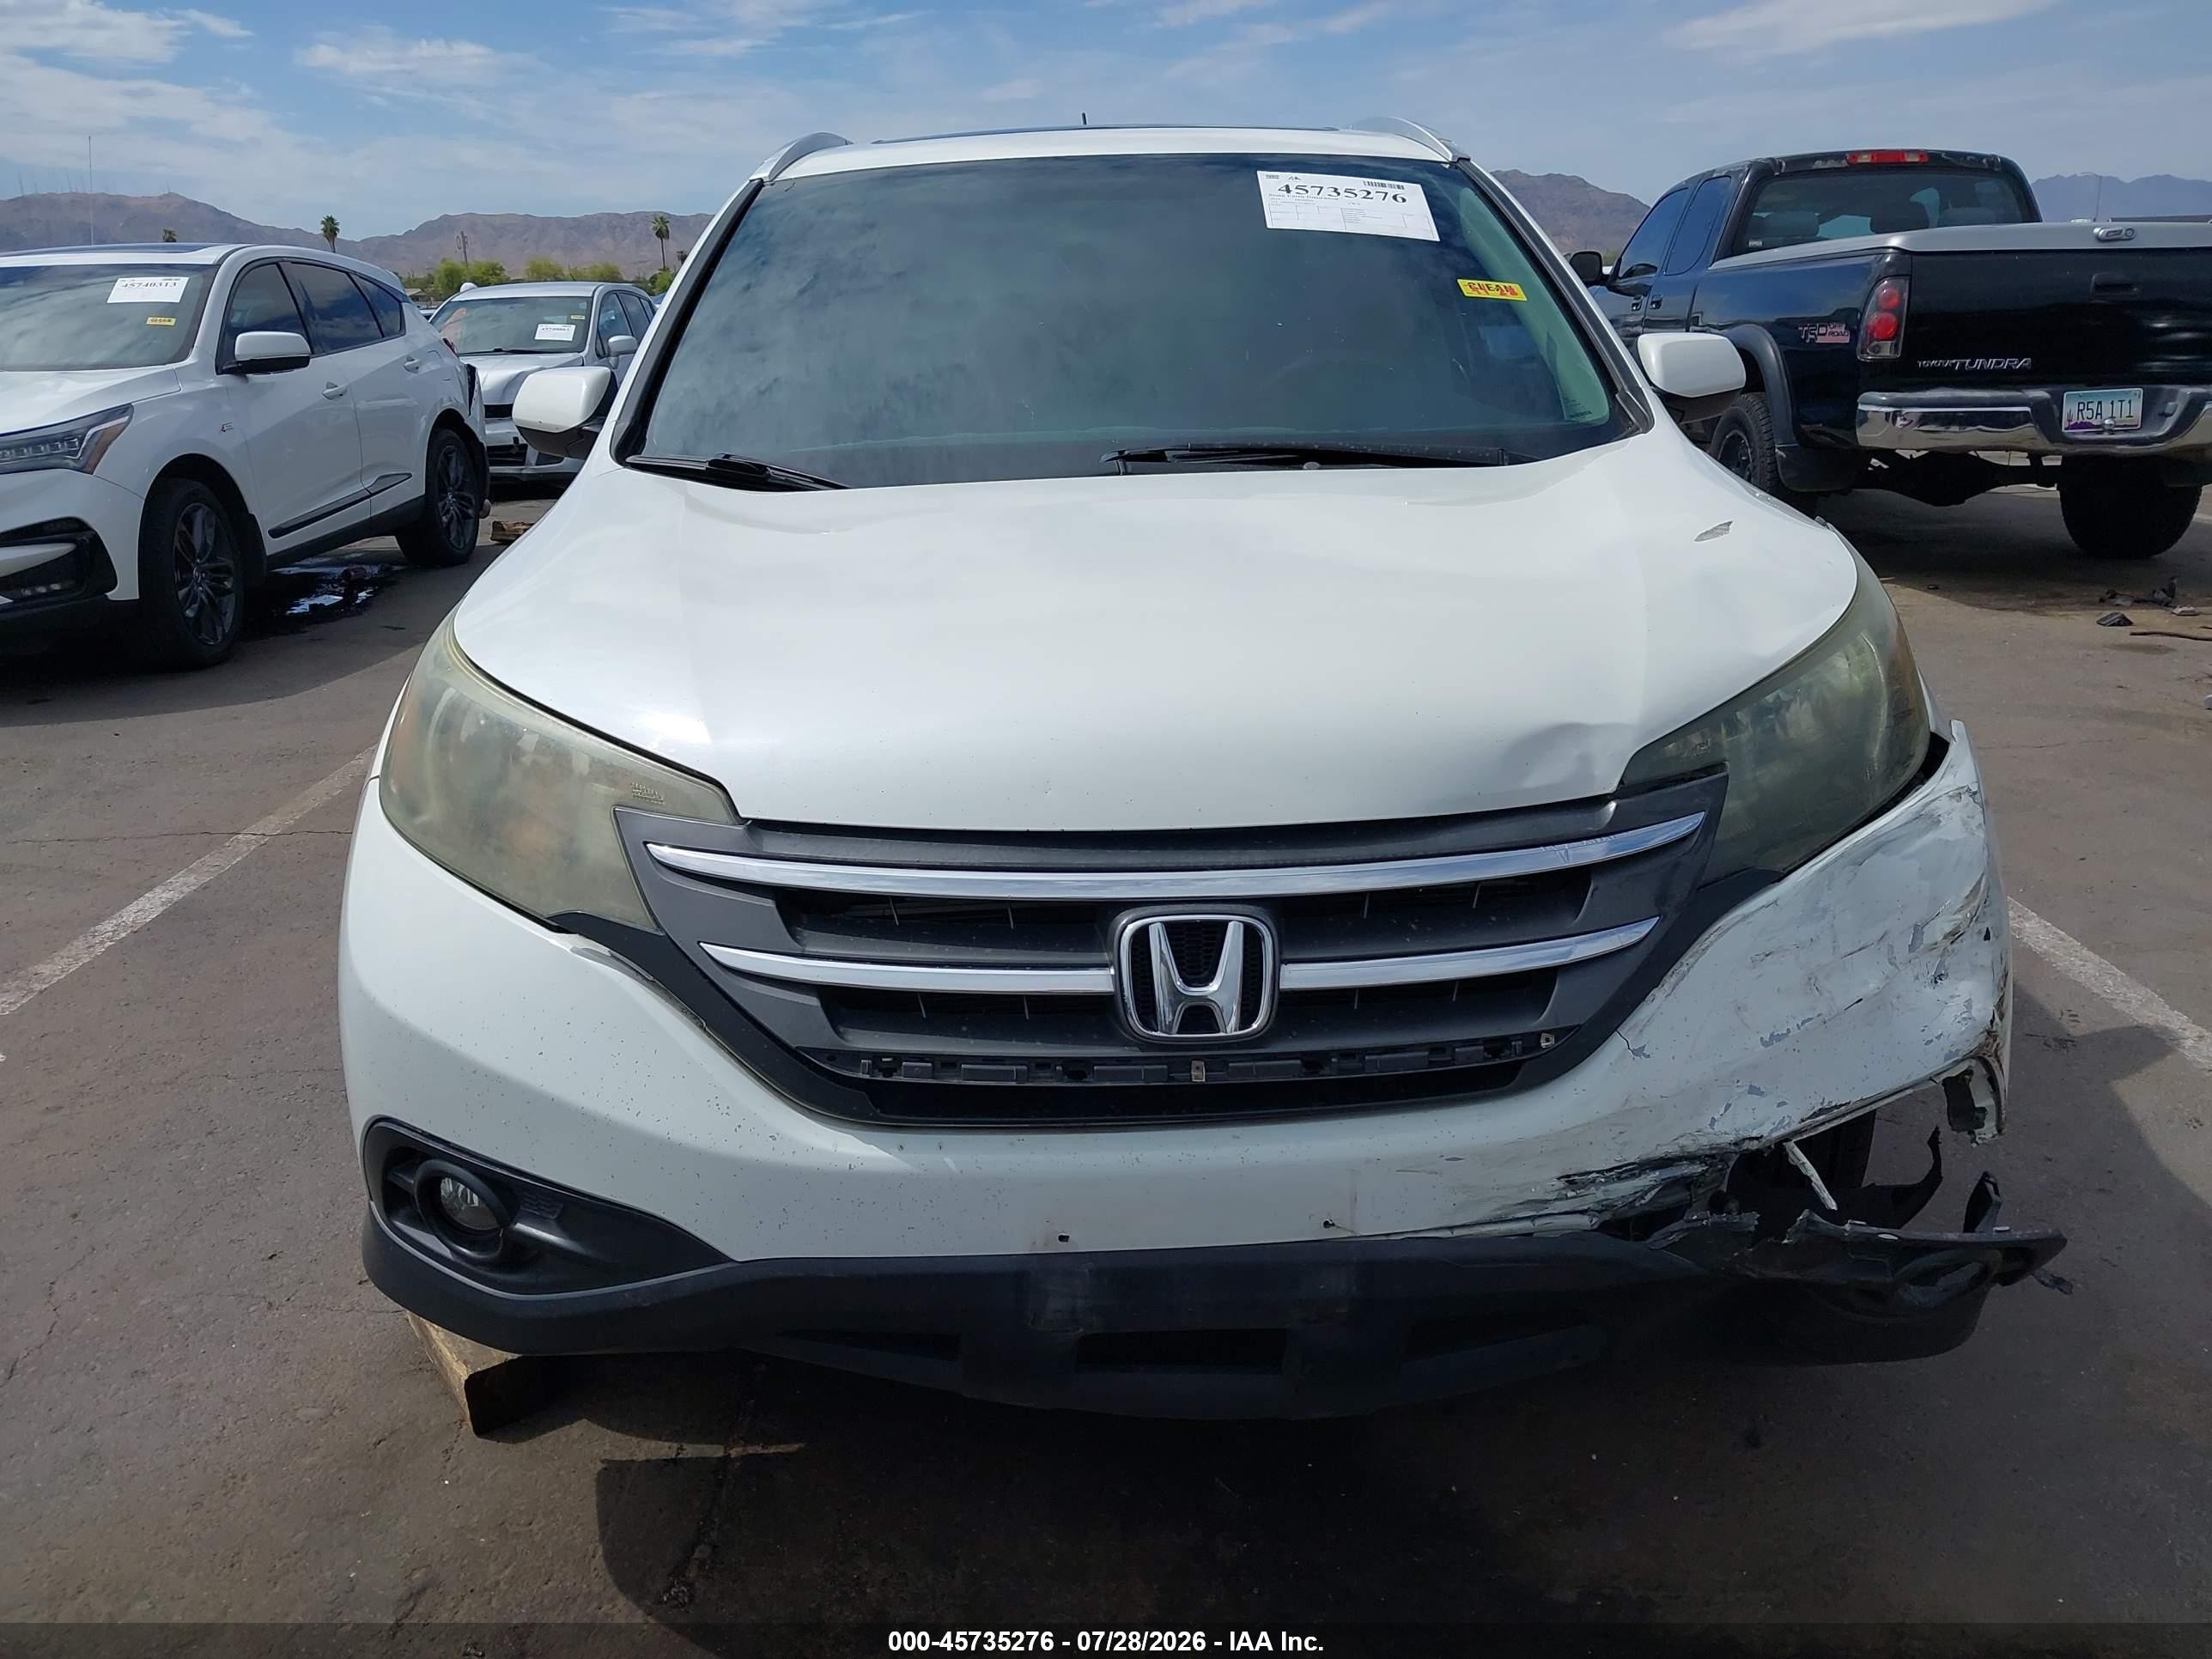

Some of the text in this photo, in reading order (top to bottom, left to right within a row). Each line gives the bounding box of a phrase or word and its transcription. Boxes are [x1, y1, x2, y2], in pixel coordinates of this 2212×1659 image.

[1277, 183, 1407, 204] 45735276
[1467, 282, 1514, 293] CLEAN
[1917, 357, 2032, 370] TOYOTA TUNDRA
[2076, 398, 2134, 421] R5A 1T1
